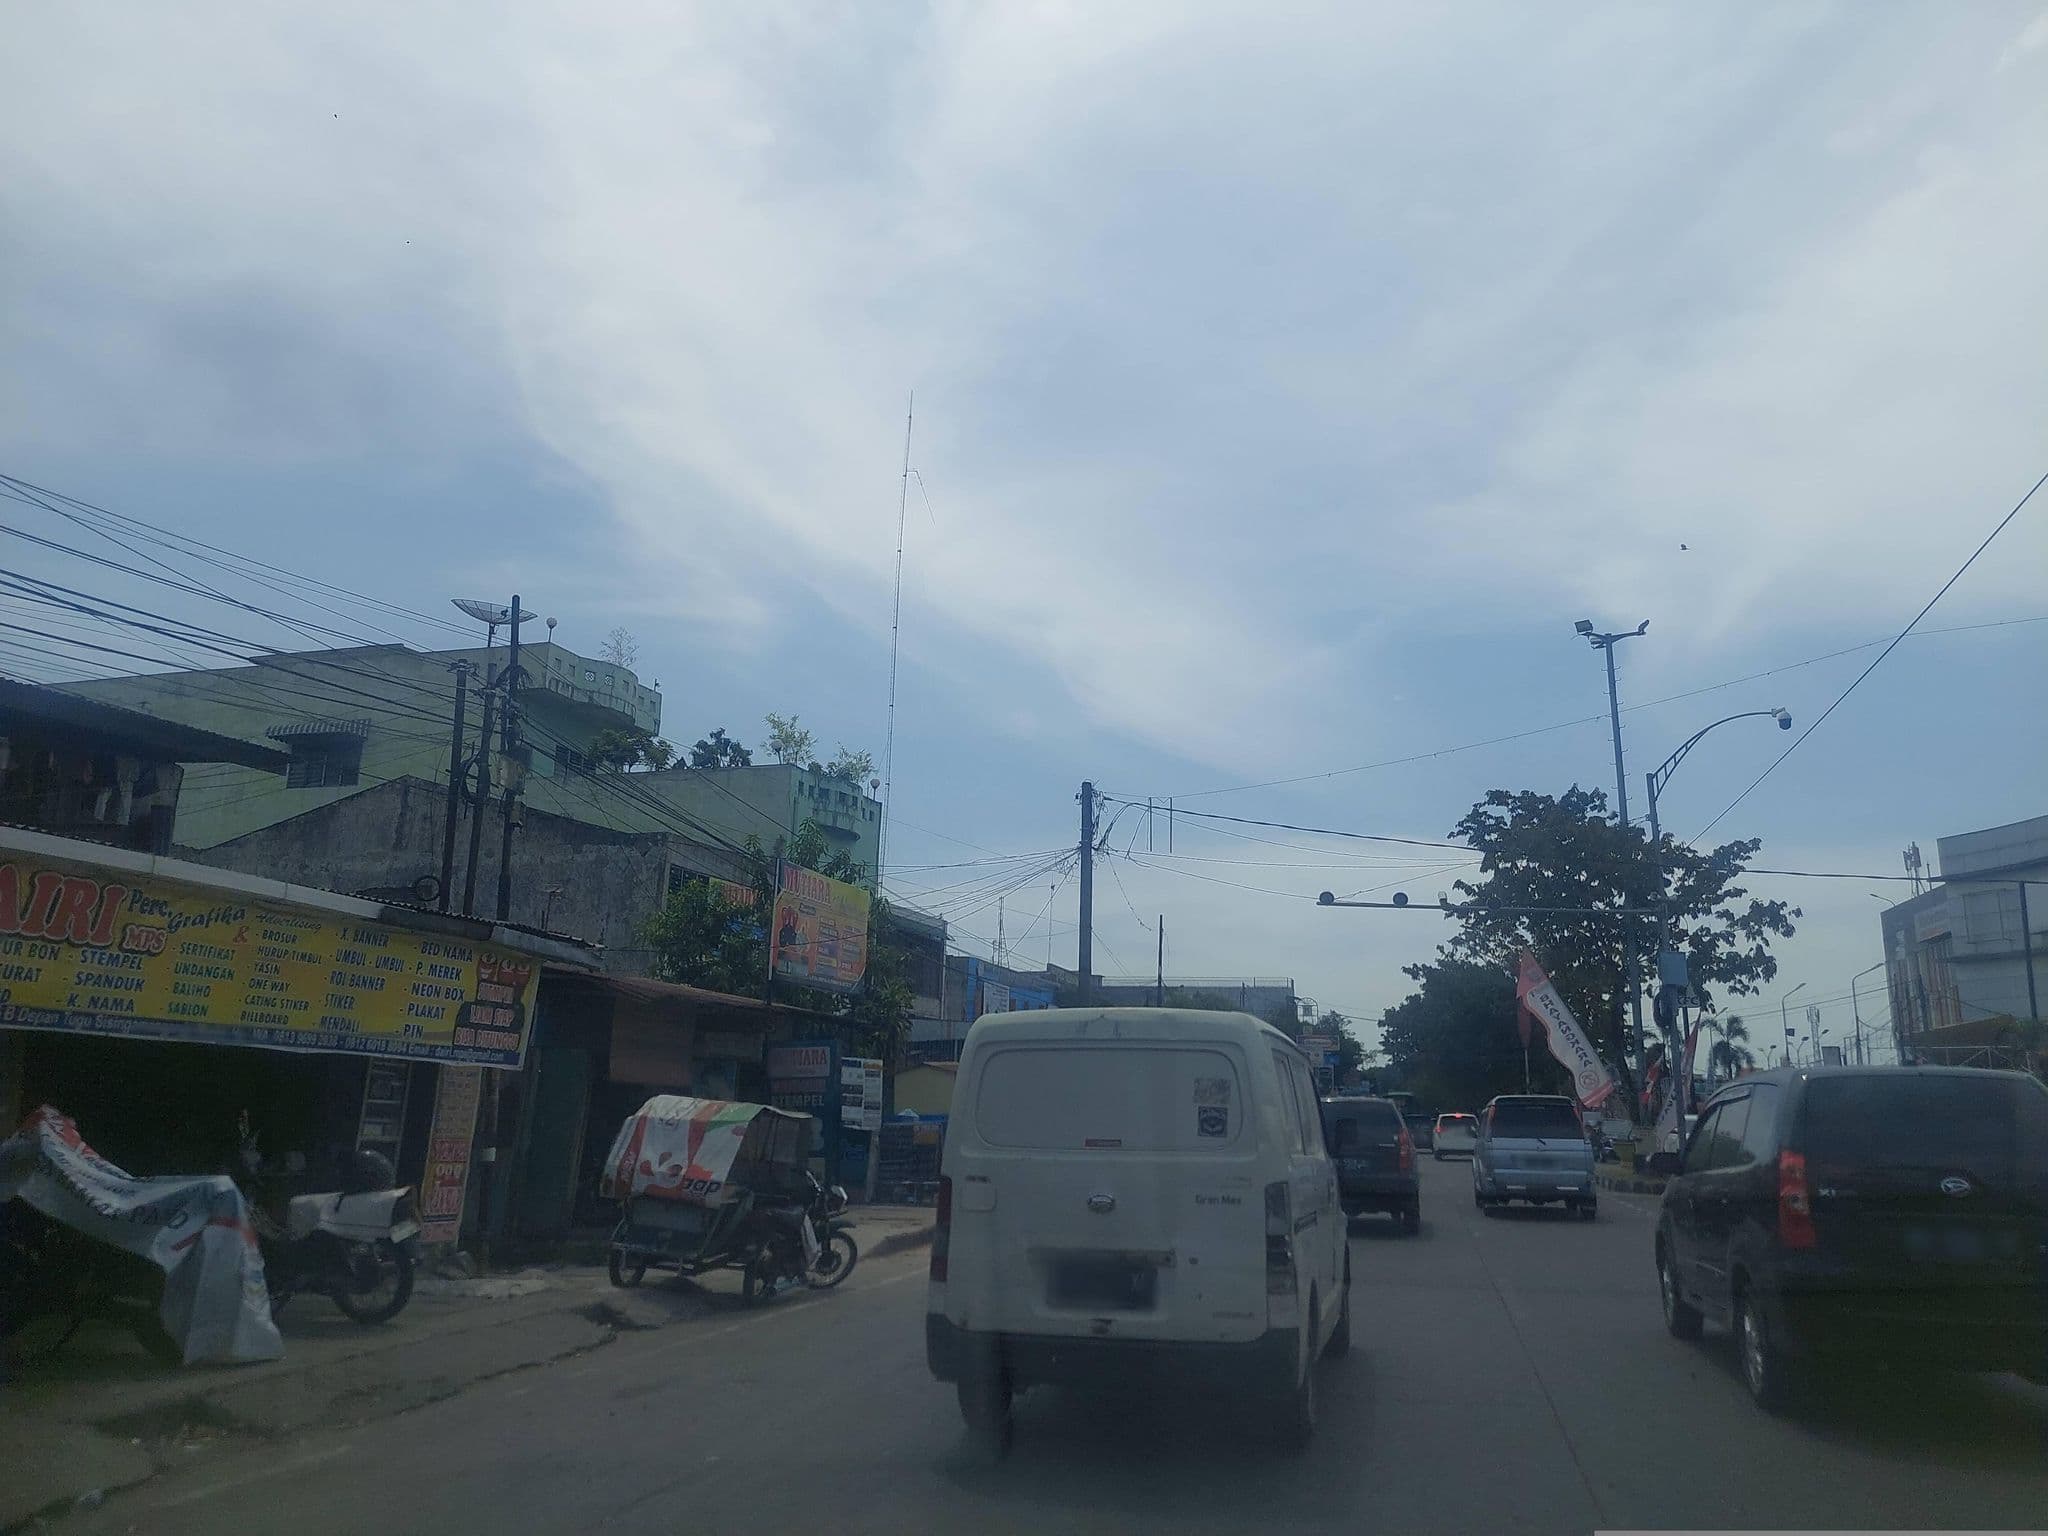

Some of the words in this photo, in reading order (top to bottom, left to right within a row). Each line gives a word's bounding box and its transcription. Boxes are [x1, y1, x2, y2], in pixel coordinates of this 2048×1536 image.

[167, 904, 247, 935] Grafika
[261, 928, 299, 945] BROSUR
[352, 928, 390, 949] BANNER
[28, 942, 61, 961] BON
[80, 949, 144, 971] STEMPEL
[179, 941, 237, 961] SERTIFIKAT
[257, 944, 290, 962] HURUP
[291, 948, 323, 965] TIMBUL
[335, 949, 367, 967] UMBUL
[421, 940, 441, 957] BED
[442, 944, 474, 963] NAMA
[0, 963, 43, 983] URAT
[174, 961, 237, 982] UNDANGAN
[253, 961, 282, 976] YASIN
[427, 964, 463, 981] MEREK
[75, 970, 146, 993] SPANDUK
[173, 980, 211, 998] BALIHO
[247, 977, 269, 991] ONE
[271, 979, 292, 994] WAY
[348, 973, 387, 992] BANNER
[322, 993, 355, 1011] STIKER
[410, 982, 441, 1000] NEON
[443, 985, 466, 1003] BOX
[87, 995, 135, 1013] NAMA
[244, 993, 277, 1009] CATING
[279, 997, 311, 1012] STIKER
[406, 1003, 446, 1021] PLAKAT
[239, 1009, 290, 1025] BILLBOARD
[402, 1023, 425, 1040] PIN
